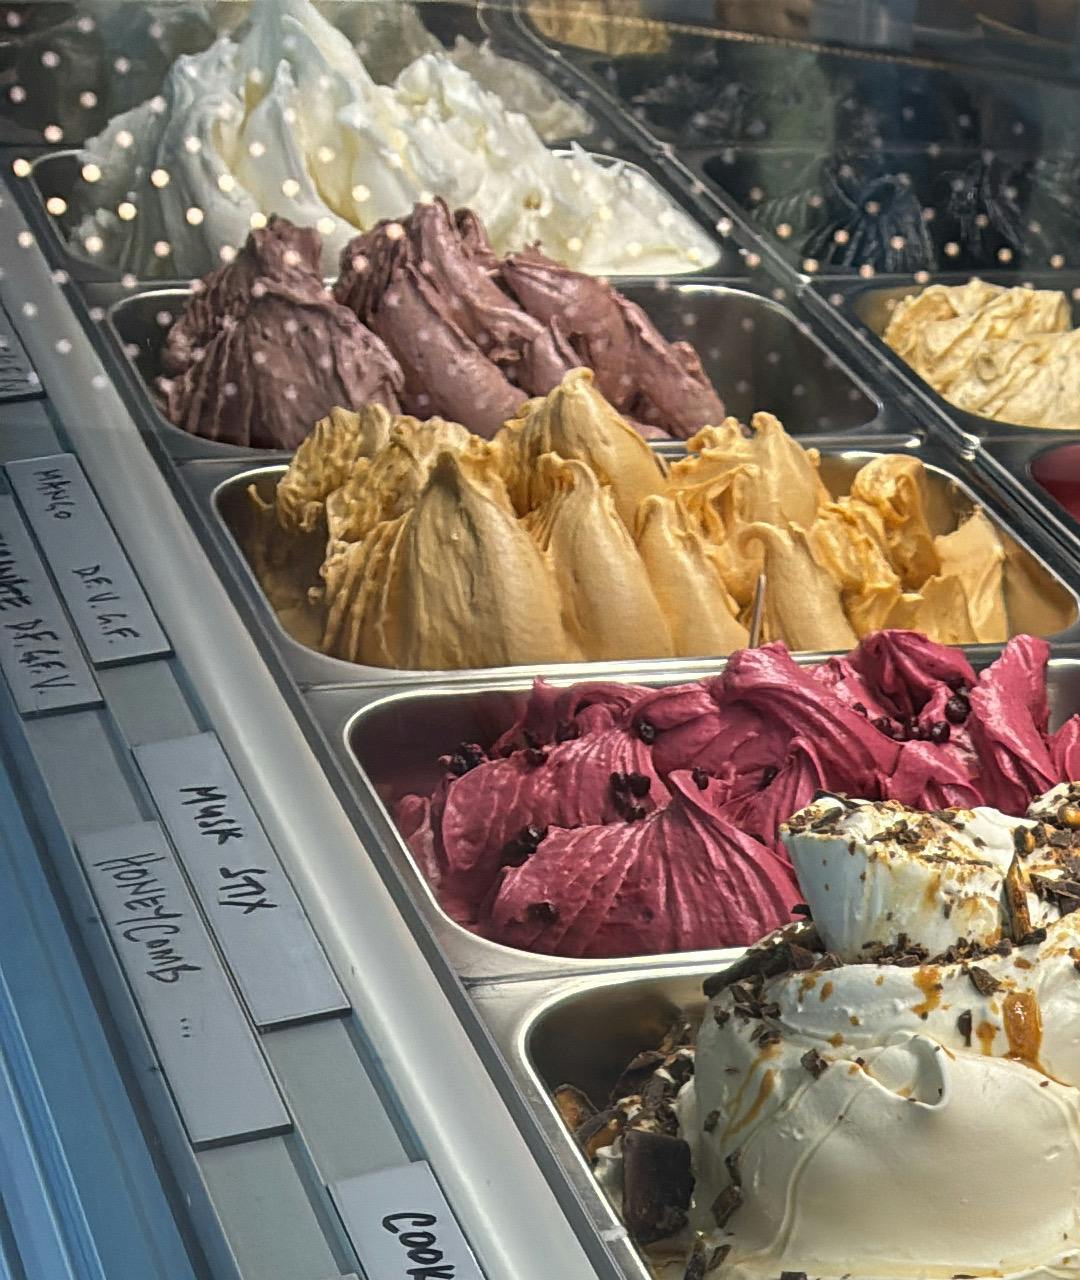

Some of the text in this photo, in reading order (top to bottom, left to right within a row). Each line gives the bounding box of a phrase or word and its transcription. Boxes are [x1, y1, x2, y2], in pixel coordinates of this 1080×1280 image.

[33, 468, 74, 519] MANGO
[179, 785, 277, 915] MUSK STIX
[94, 852, 202, 984] HONEYCOMB
